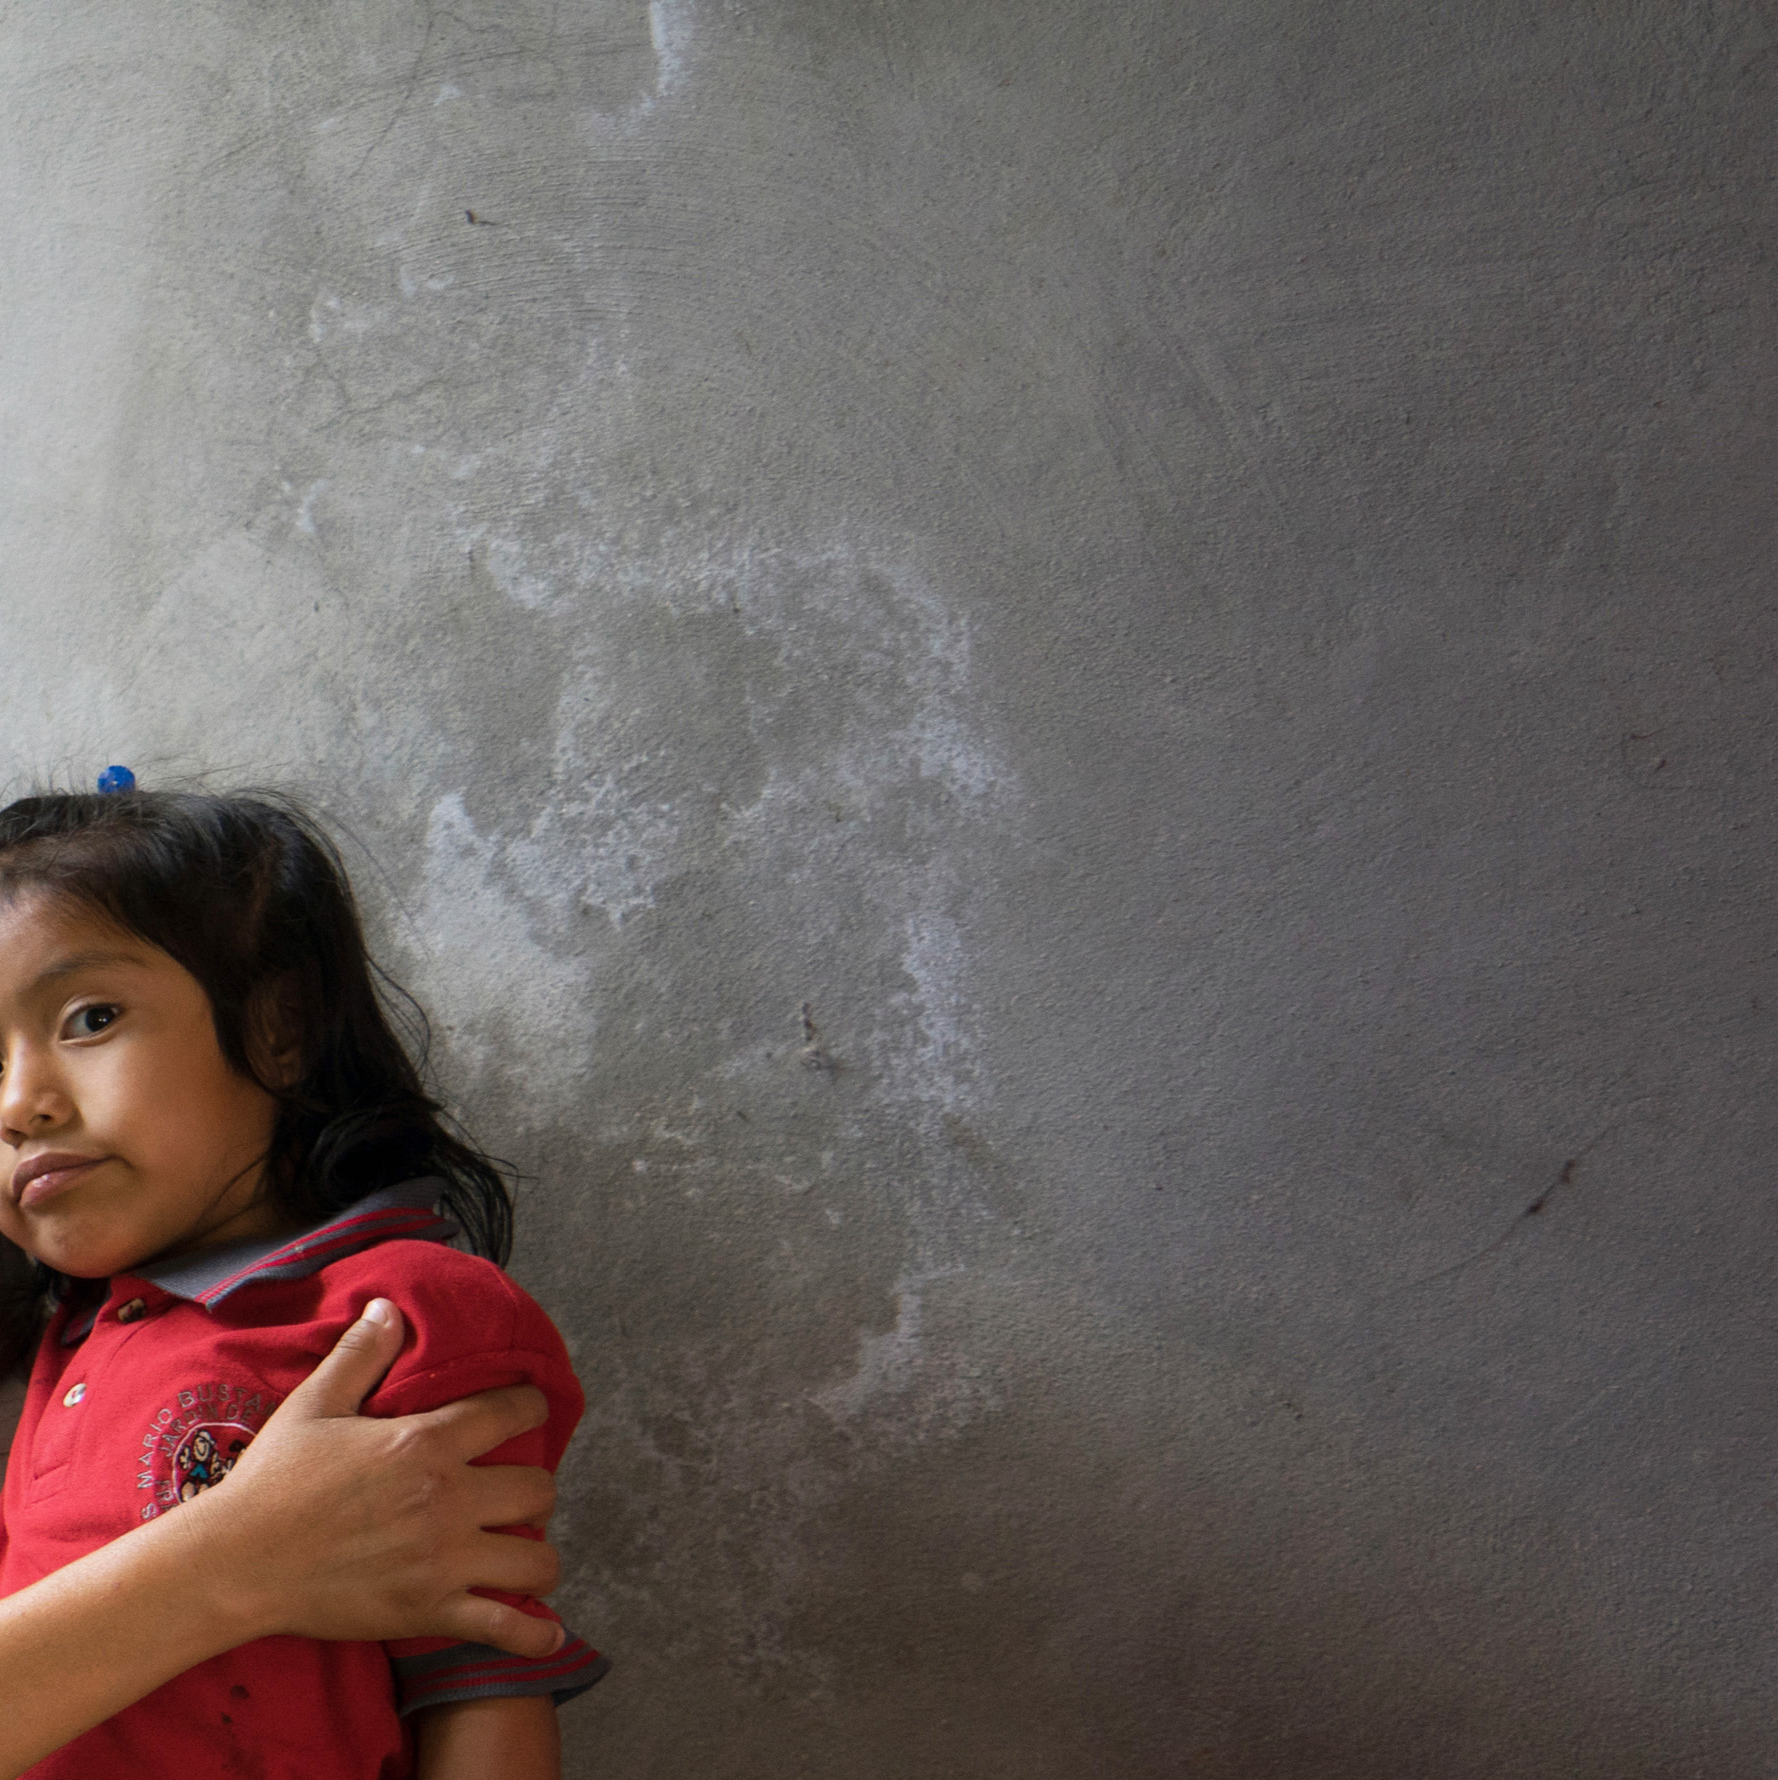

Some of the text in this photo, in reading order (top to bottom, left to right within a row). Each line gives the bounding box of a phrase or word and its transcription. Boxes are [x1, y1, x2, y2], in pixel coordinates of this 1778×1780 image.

[137, 1408, 173, 1489] MARIO
[160, 1404, 255, 1458] JARDIN DE
